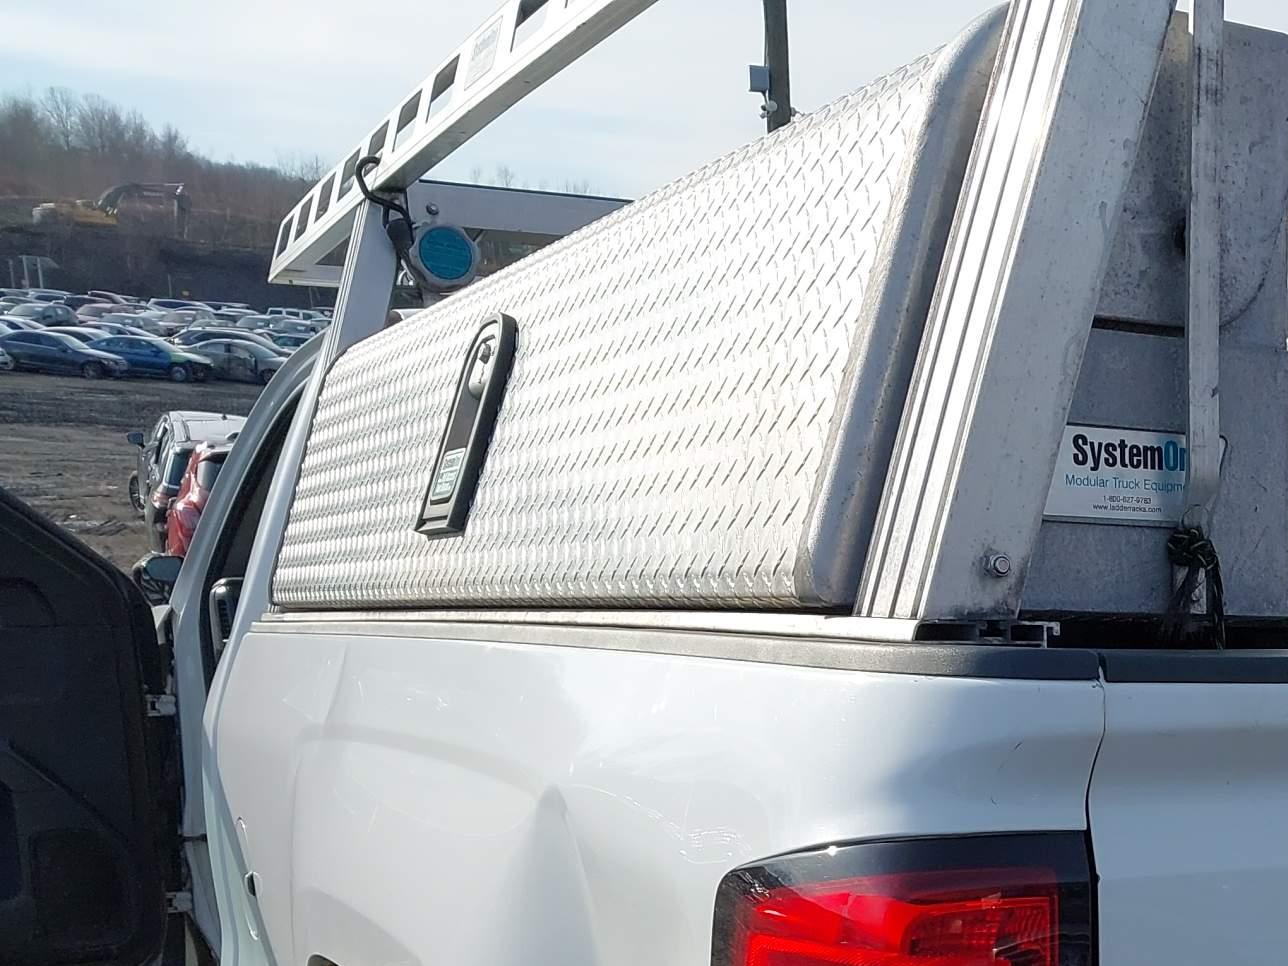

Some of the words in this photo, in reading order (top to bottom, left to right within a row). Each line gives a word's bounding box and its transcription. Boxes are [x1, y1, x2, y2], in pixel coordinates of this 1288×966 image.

[1065, 474, 1109, 488] Modular
[1112, 477, 1141, 489] Truck
[1092, 503, 1162, 513] www.ladderracks.com
